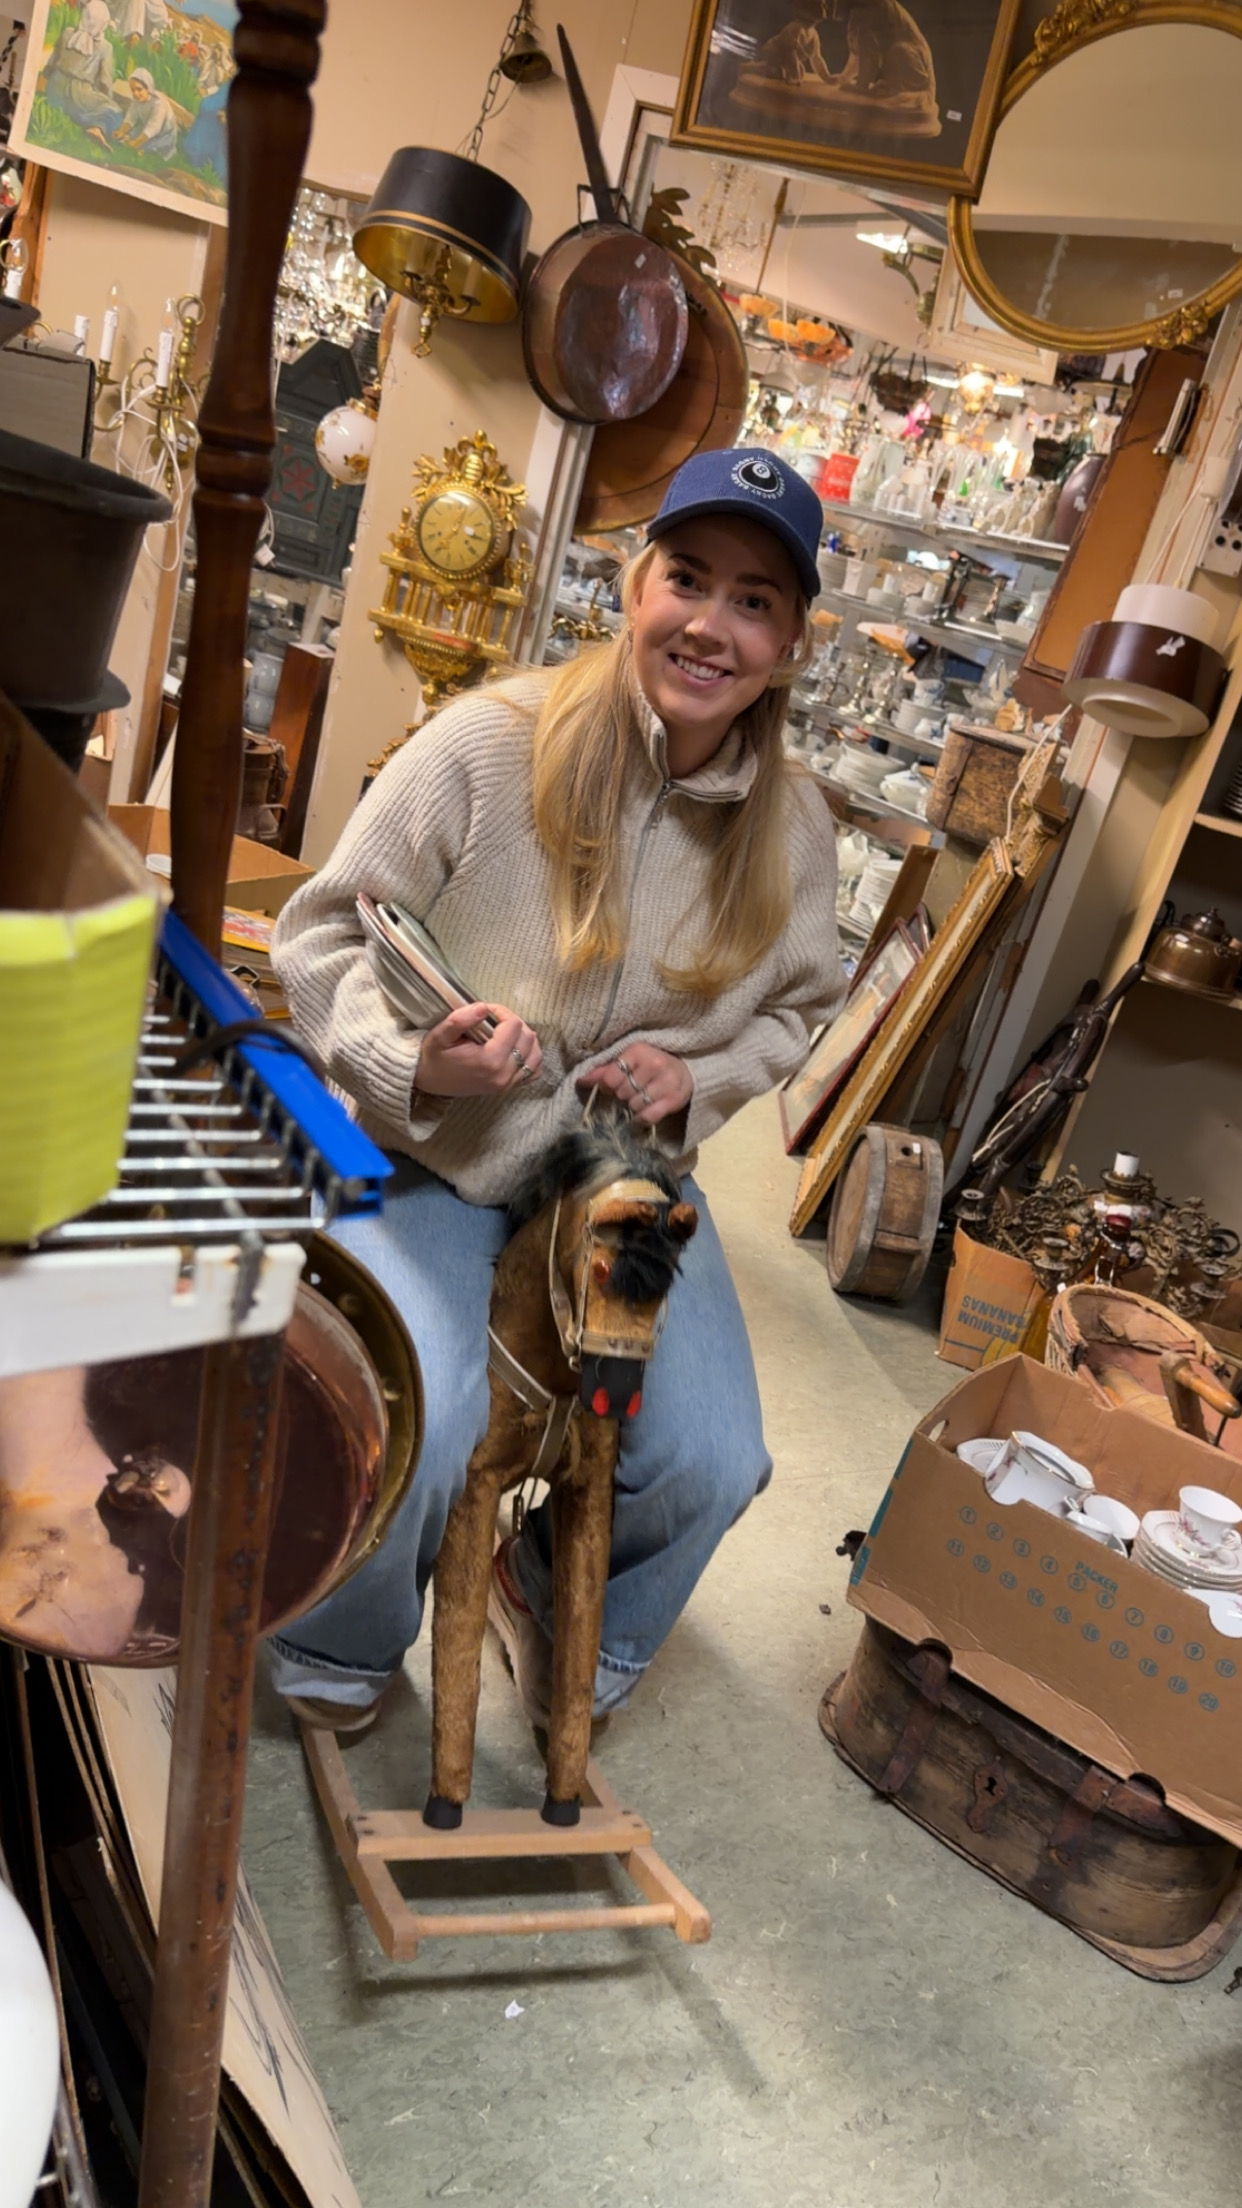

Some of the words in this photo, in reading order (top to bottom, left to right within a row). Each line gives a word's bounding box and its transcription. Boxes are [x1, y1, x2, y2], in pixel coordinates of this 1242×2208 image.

[957, 1309, 1019, 1345] PREMIUM
[962, 1295, 1025, 1329] BANANAS
[1075, 1560, 1118, 1595] PACKER
